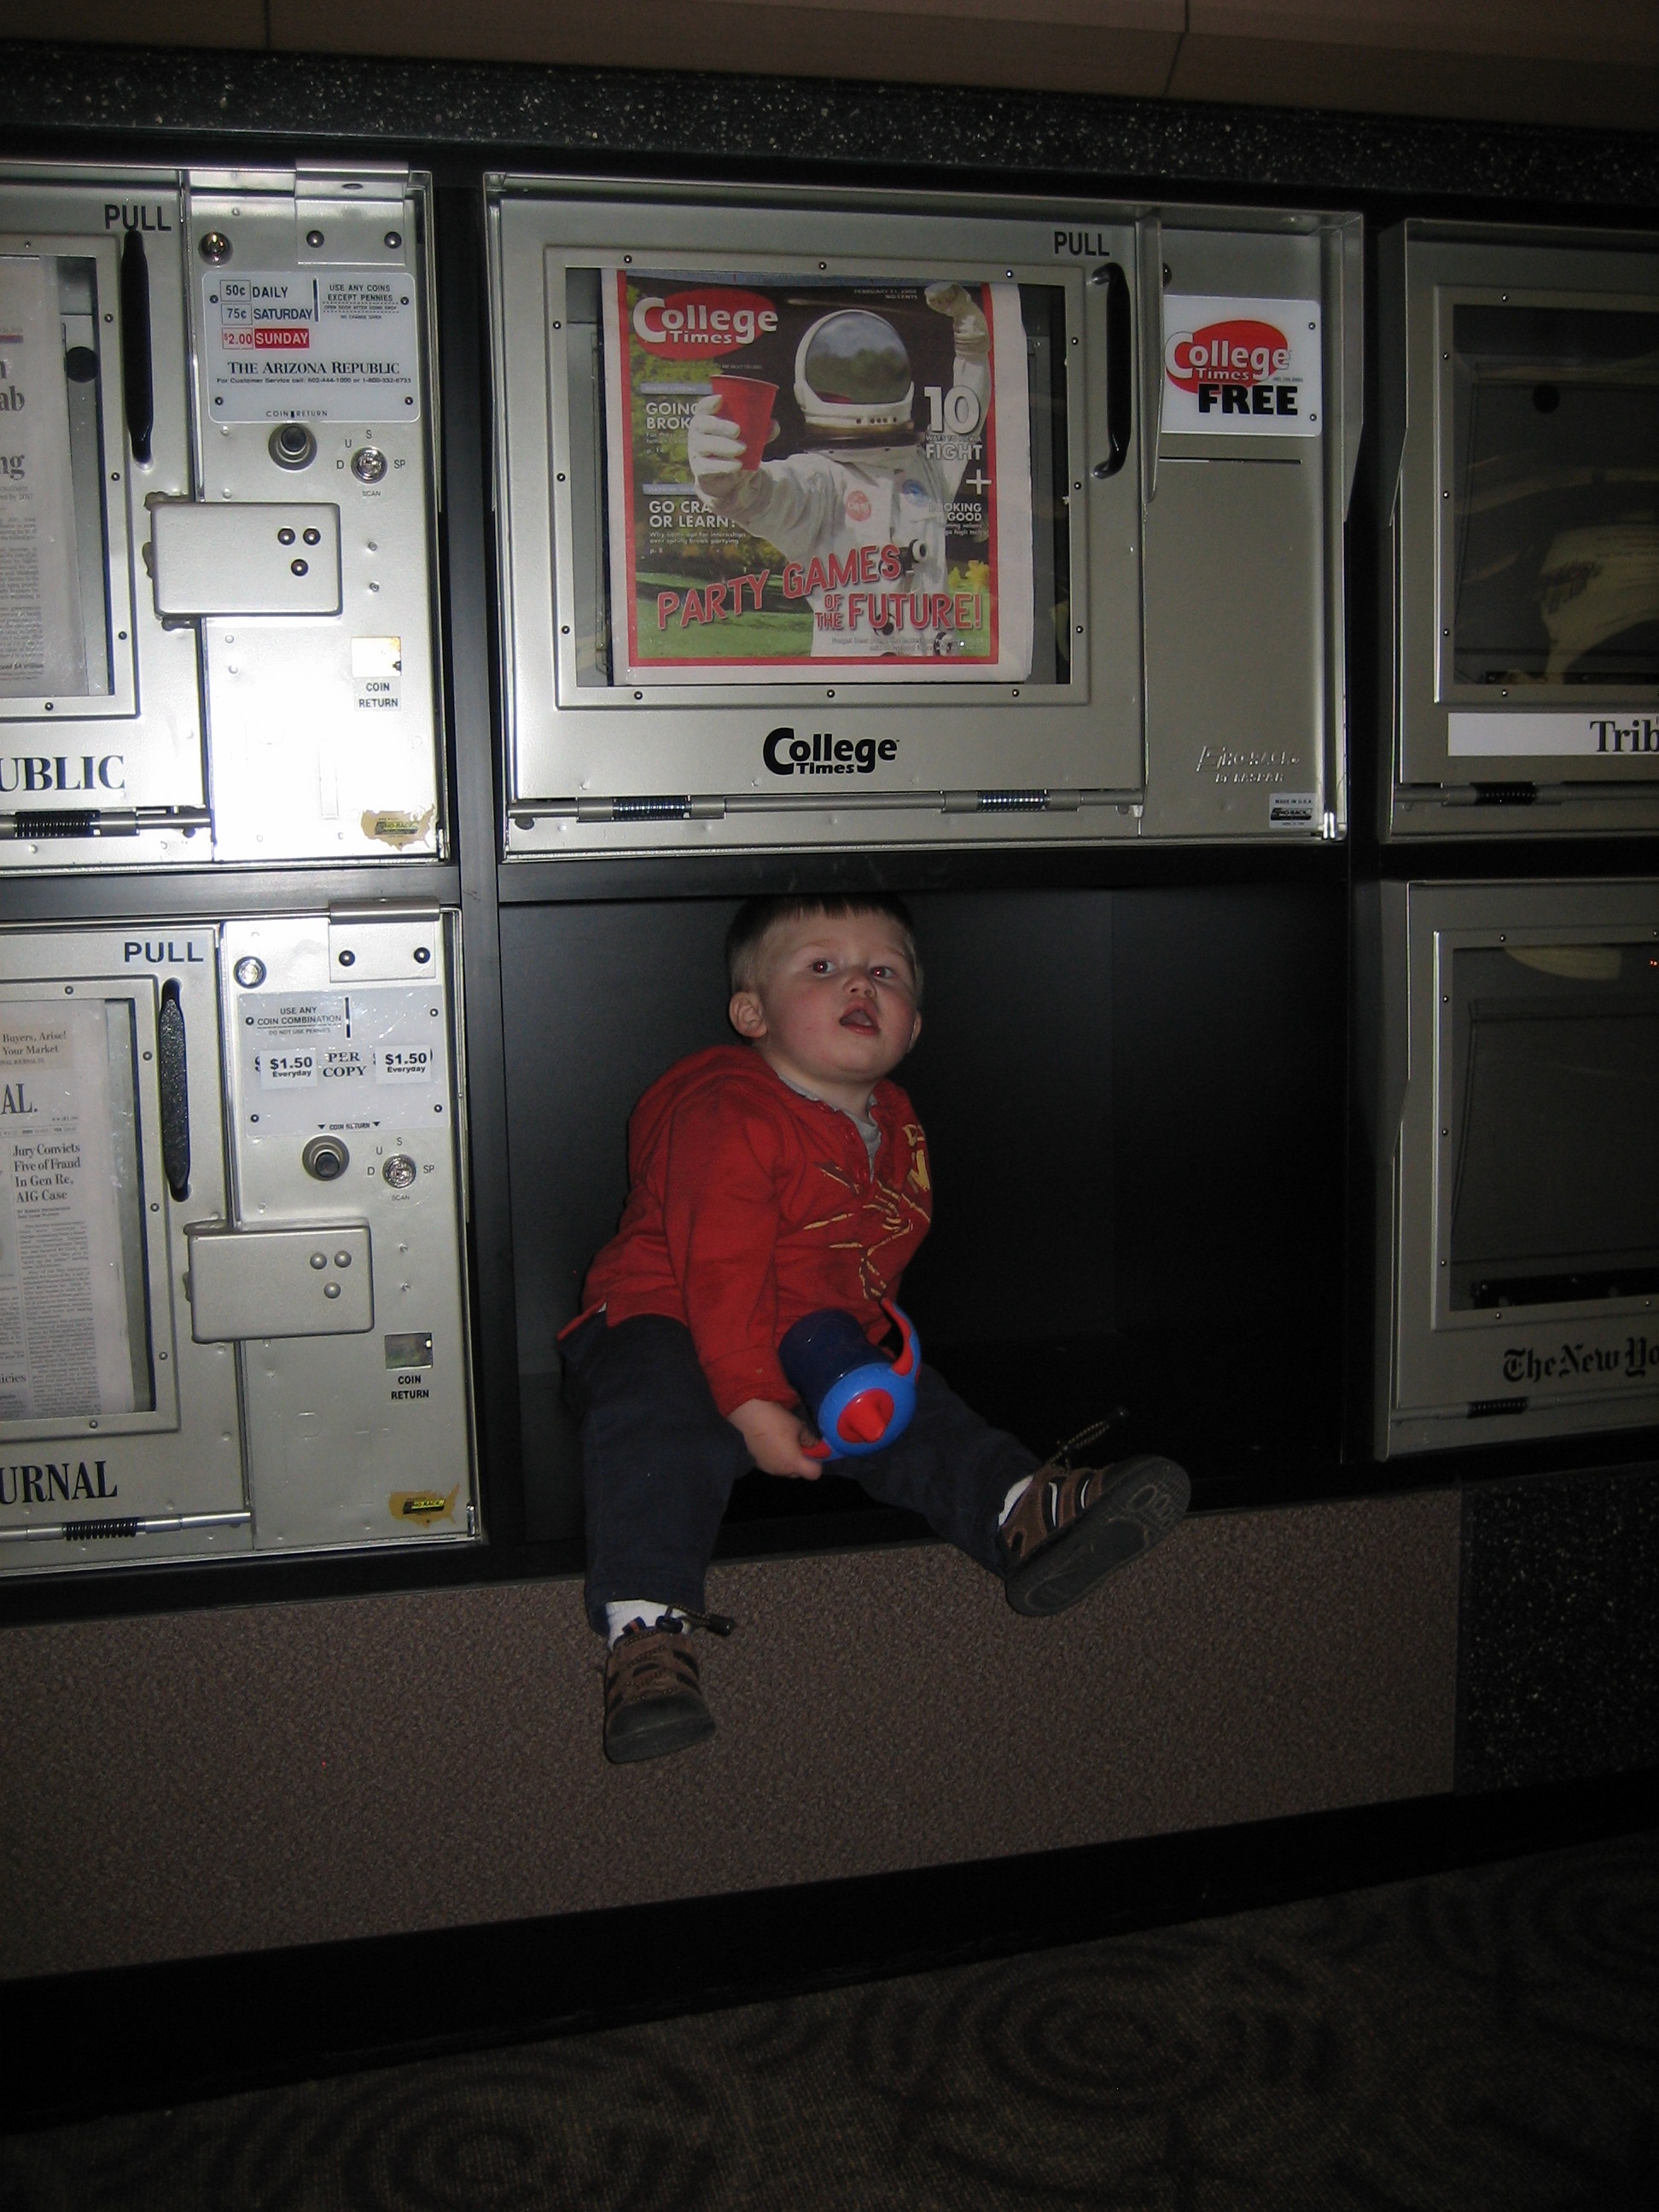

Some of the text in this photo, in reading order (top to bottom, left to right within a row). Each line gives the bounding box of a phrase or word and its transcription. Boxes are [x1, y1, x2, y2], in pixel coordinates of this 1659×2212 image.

[104, 204, 172, 231] PULL
[1054, 231, 1109, 256] PULL
[225, 284, 288, 298] 50¢ DAILY
[227, 308, 313, 320] 75¢ SATURDAY
[633, 296, 779, 345] College
[224, 332, 309, 345] $2.00 SUNDAY
[669, 330, 732, 344] Times
[1164, 330, 1291, 381] College
[227, 361, 400, 375] THE ARIZONA REPUBLIC
[1196, 367, 1250, 381] Times
[1198, 383, 1299, 416] FREE
[924, 385, 981, 435] 10
[365, 429, 372, 439] S
[345, 439, 352, 449] U
[926, 444, 983, 460] FIGHT
[336, 459, 406, 469] D SP
[649, 500, 675, 514] GO
[649, 515, 672, 527] OR
[947, 512, 982, 521] GOOD
[656, 544, 901, 631] PARTY GAMES
[824, 594, 843, 611] OF
[848, 592, 982, 629] FUTURE!
[814, 612, 844, 629] THE
[365, 682, 390, 693] COIN
[358, 696, 399, 708] RETURN
[1590, 719, 1659, 753] Trib
[762, 727, 898, 776] College
[0, 755, 125, 792] UBLIC
[795, 762, 855, 774] Times
[124, 941, 204, 963] PULL
[281, 1015, 341, 1025] COMBINATION
[3, 1030, 67, 1044] Buyers, Arise!
[3, 1045, 59, 1056] Your Market
[326, 1051, 360, 1062] PER
[270, 1057, 313, 1070] $1.50
[385, 1052, 428, 1065] $1.50
[272, 1069, 312, 1078] Everyday
[323, 1065, 368, 1077] COPY
[0, 1083, 38, 1115] AL.
[396, 1137, 403, 1146] S
[13, 1143, 81, 1158] Jury Convicts
[375, 1146, 383, 1155] U
[15, 1156, 81, 1172] Five of Fraud
[367, 1165, 435, 1176] D SP
[15, 1176, 27, 1187] In
[30, 1174, 52, 1186] Gen
[16, 1189, 67, 1203] AIG Case
[1503, 1348, 1557, 1382] The
[1558, 1342, 1621, 1378] New
[398, 1375, 422, 1385] COIN
[391, 1389, 429, 1400] RETURN
[0, 1460, 118, 1505] URNAL
